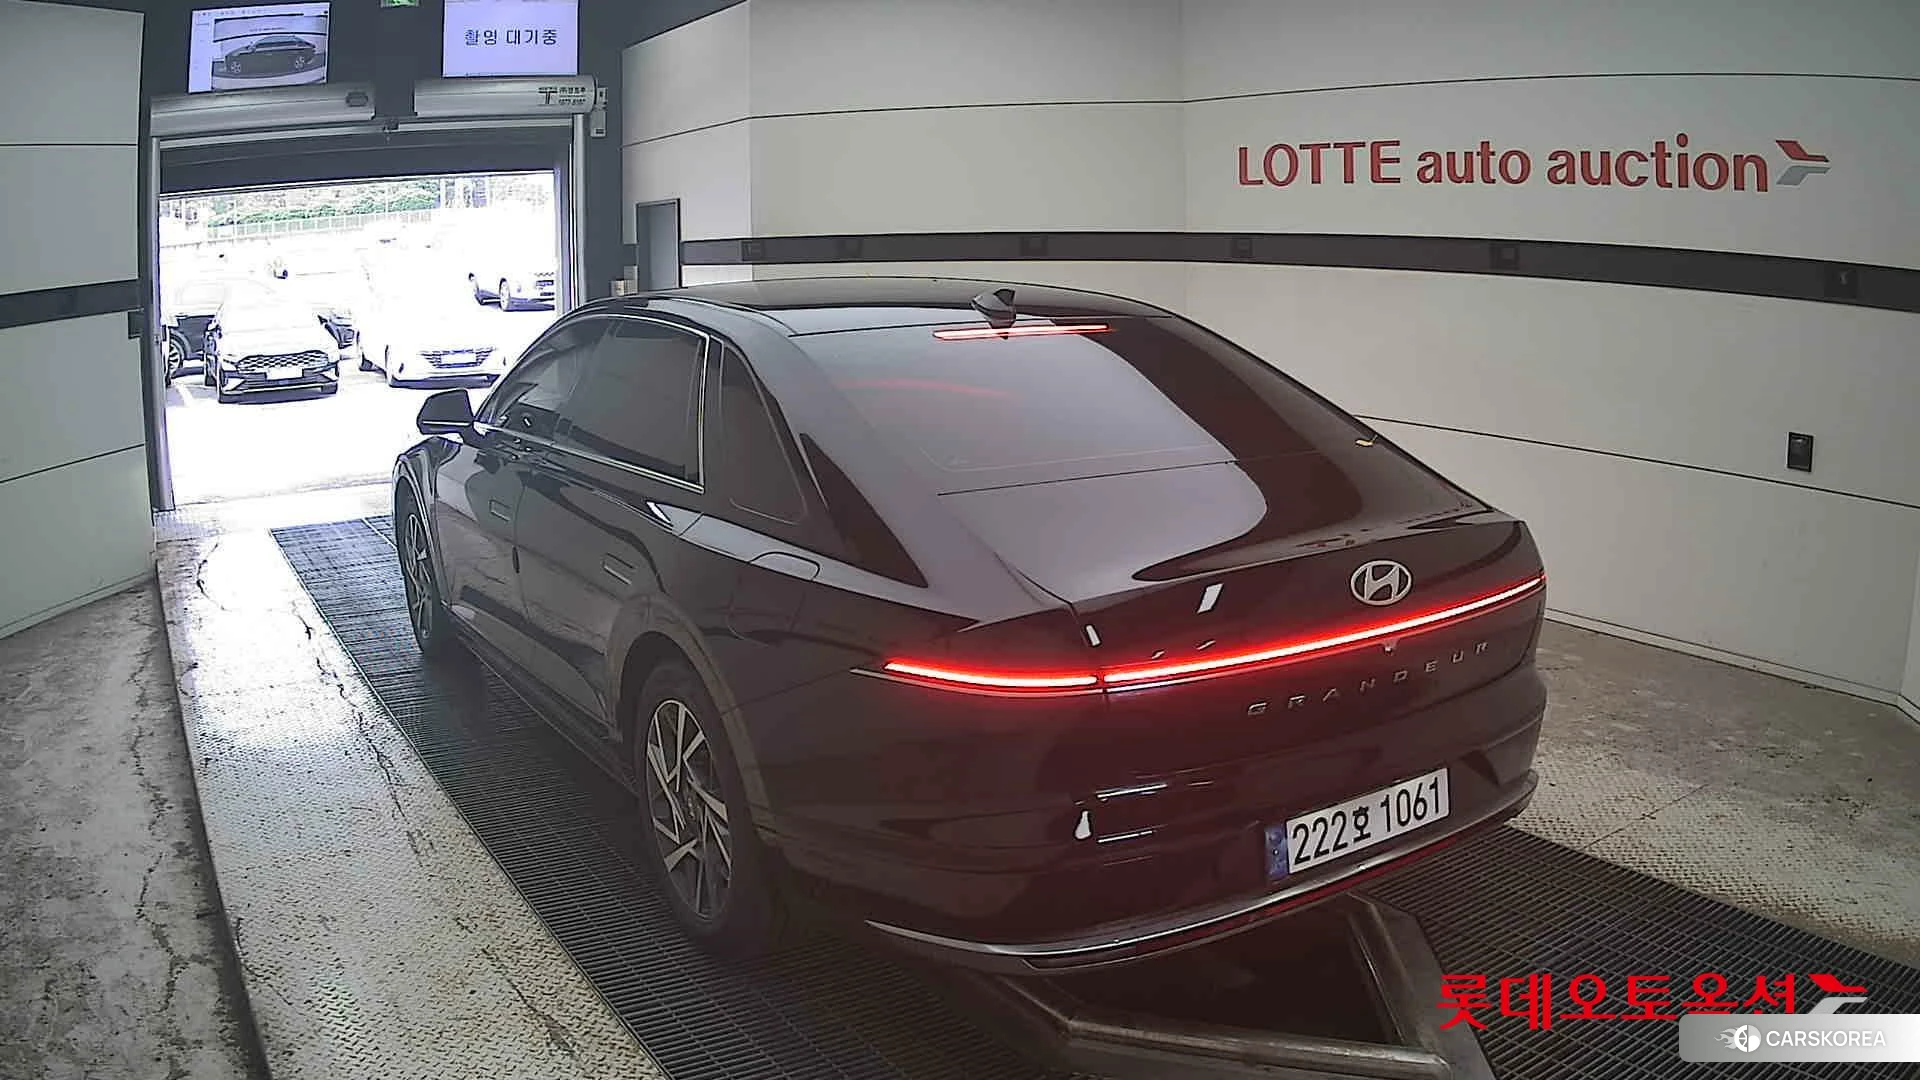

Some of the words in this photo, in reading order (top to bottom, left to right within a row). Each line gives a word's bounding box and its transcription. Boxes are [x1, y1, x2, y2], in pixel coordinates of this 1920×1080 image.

[506, 29, 558, 46] 대기중
[1238, 139, 1401, 187] LOTTE
[1416, 140, 1531, 184] auto
[1546, 132, 1768, 193] auction
[1247, 641, 1489, 715] GRANDEUR
[1292, 806, 1372, 866] 222호
[1380, 776, 1440, 833] 1061
